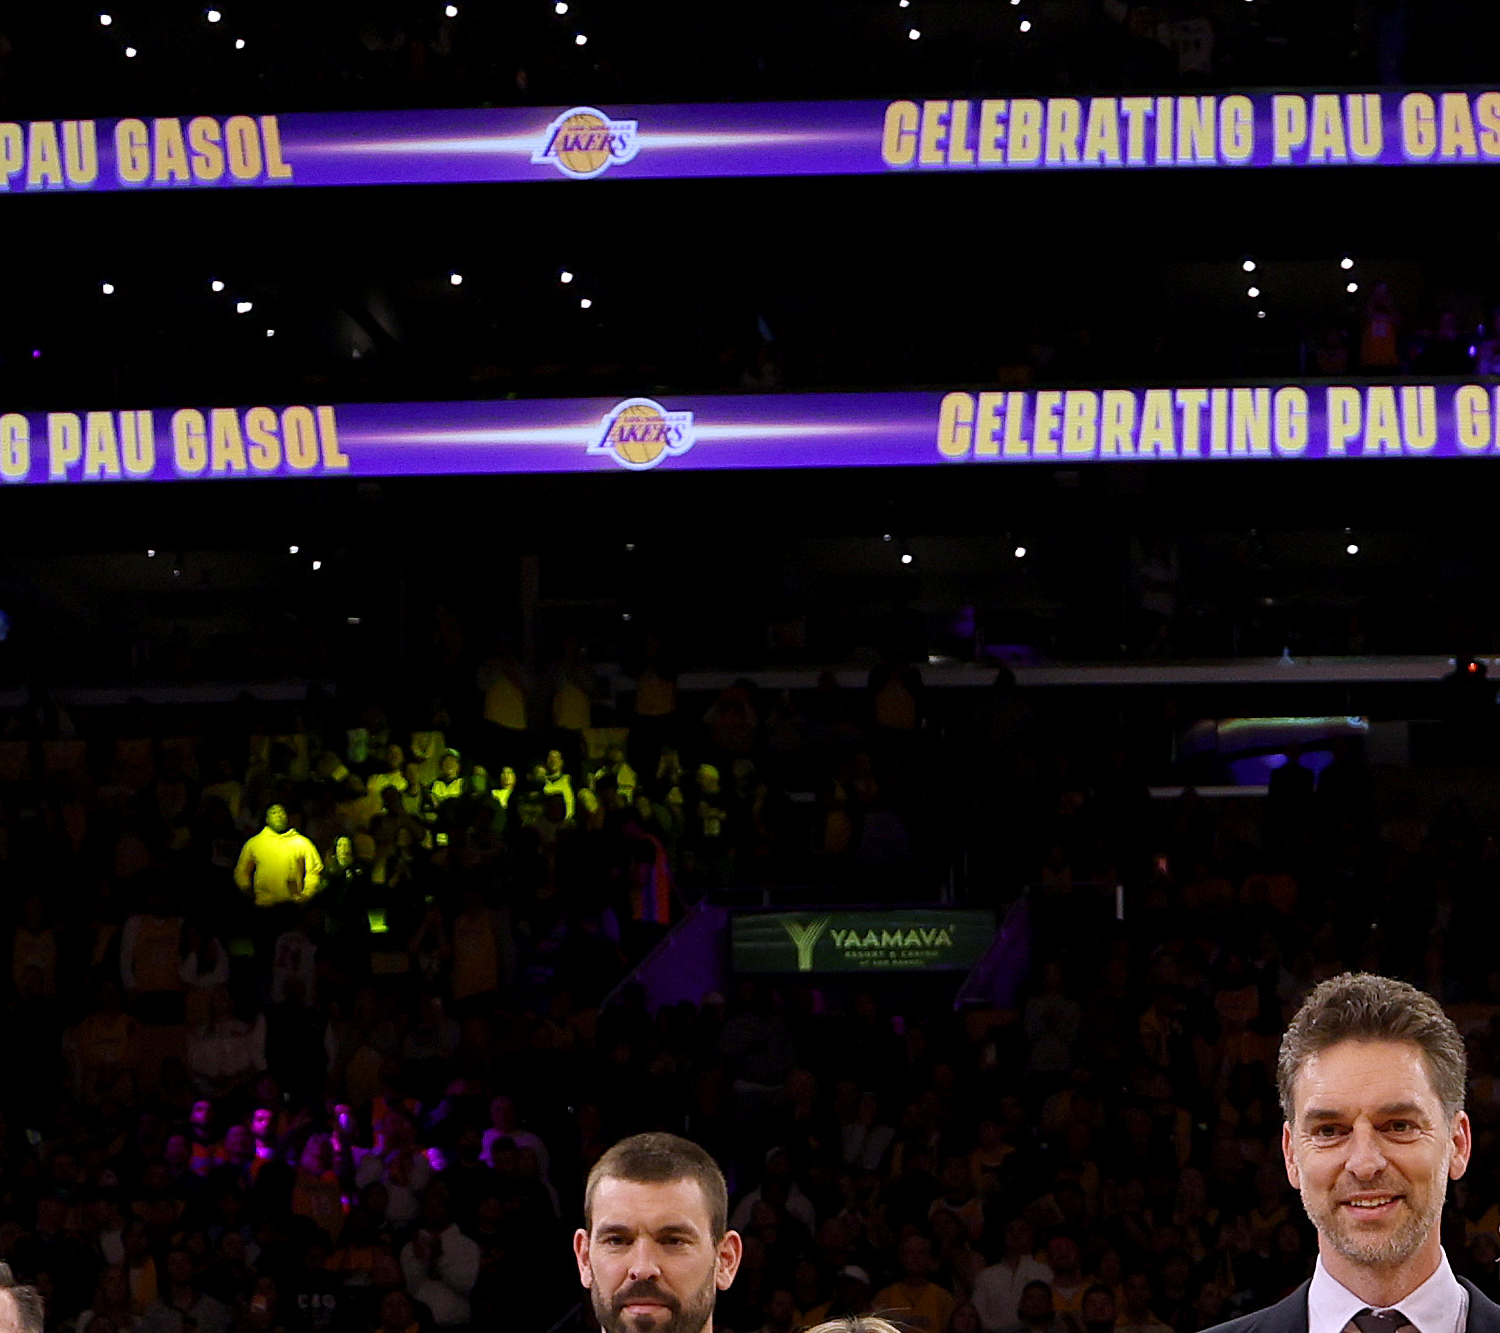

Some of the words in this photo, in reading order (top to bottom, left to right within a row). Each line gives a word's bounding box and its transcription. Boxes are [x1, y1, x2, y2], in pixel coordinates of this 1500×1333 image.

[116, 114, 294, 184] GASOL
[543, 126, 633, 160] LAKERS
[883, 93, 1254, 167] CELEBRATING
[1275, 92, 1384, 159] PAU
[49, 409, 156, 476] PAU
[173, 404, 350, 474] GASOL
[599, 416, 689, 450] LAKERS
[938, 384, 1308, 458] CELEBRATING
[1330, 384, 1438, 451] PAU
